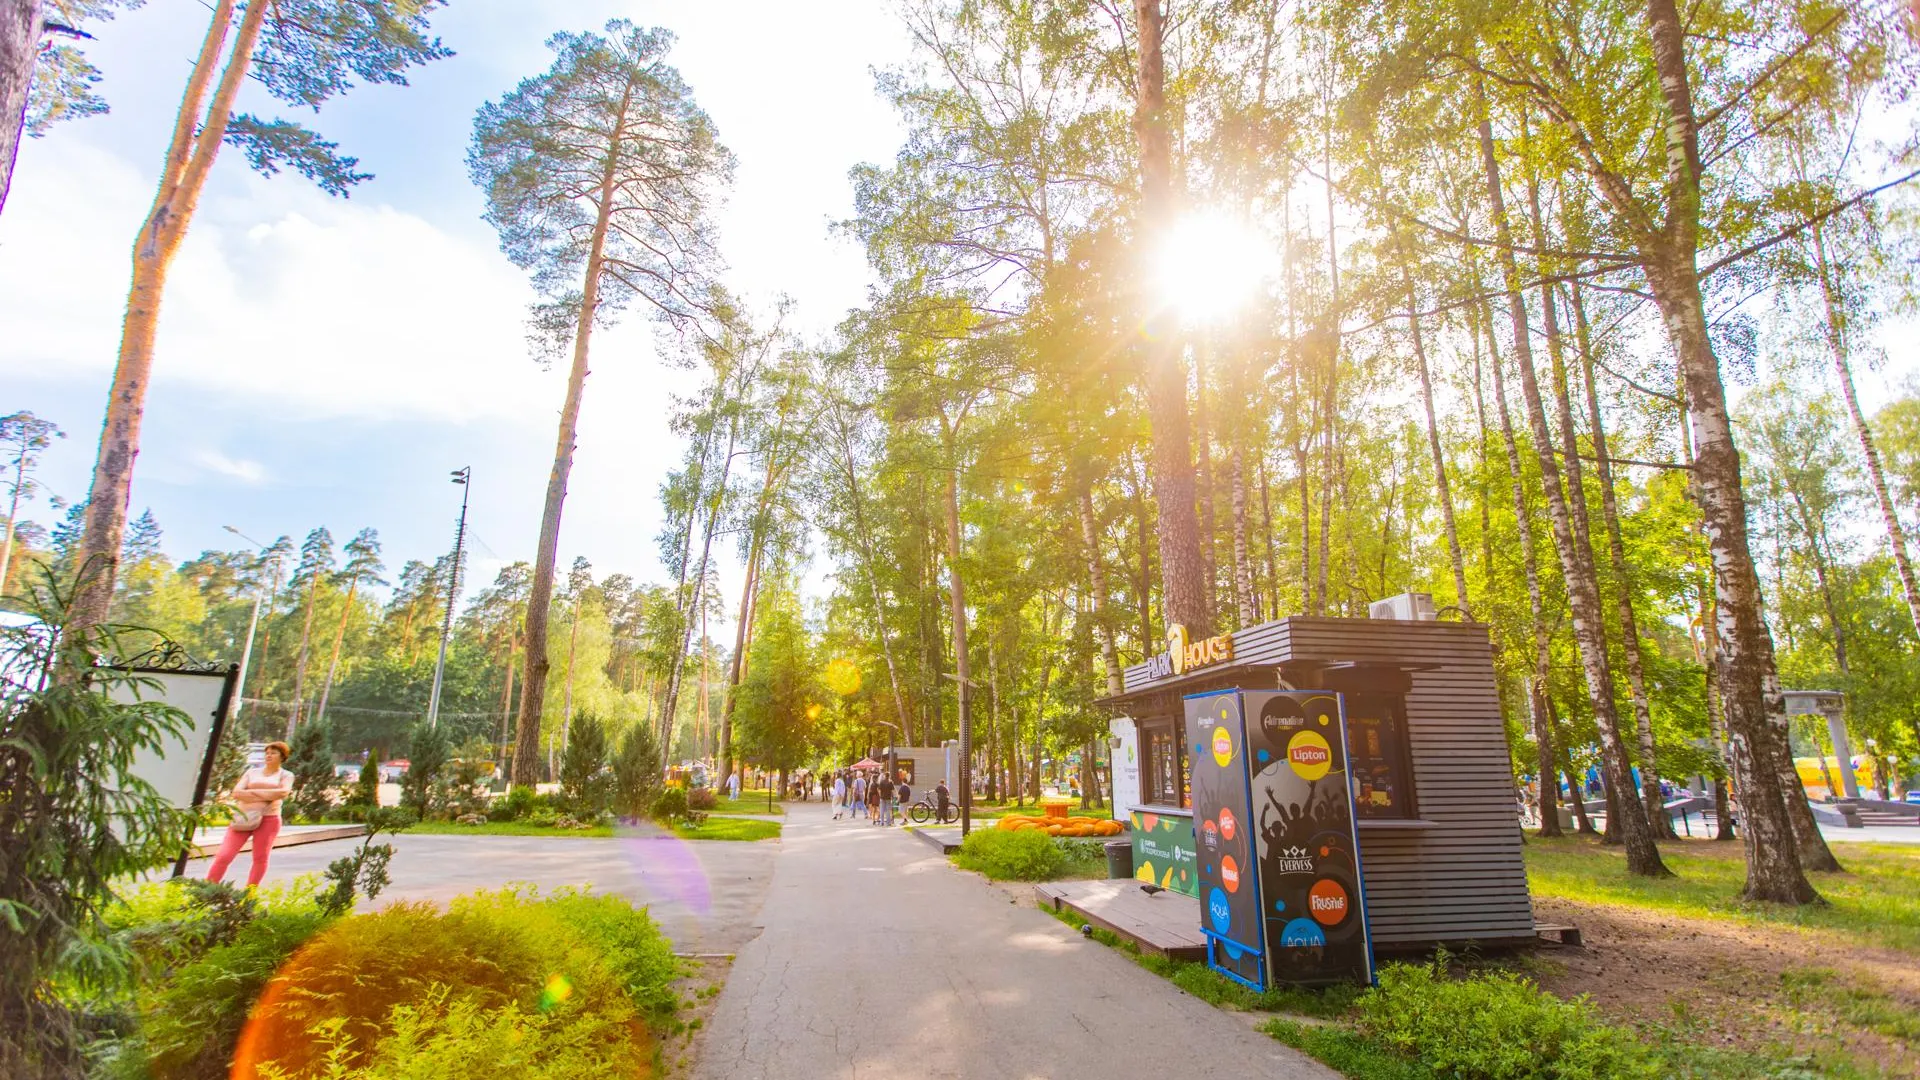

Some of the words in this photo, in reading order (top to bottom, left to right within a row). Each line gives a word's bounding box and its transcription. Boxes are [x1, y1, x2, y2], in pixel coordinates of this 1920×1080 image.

[1147, 650, 1172, 679] PARK
[1183, 632, 1232, 670] HOUSE
[1293, 750, 1326, 762] Lipton
[1280, 859, 1313, 872] EVERVESS
[1211, 902, 1228, 919] AQUA
